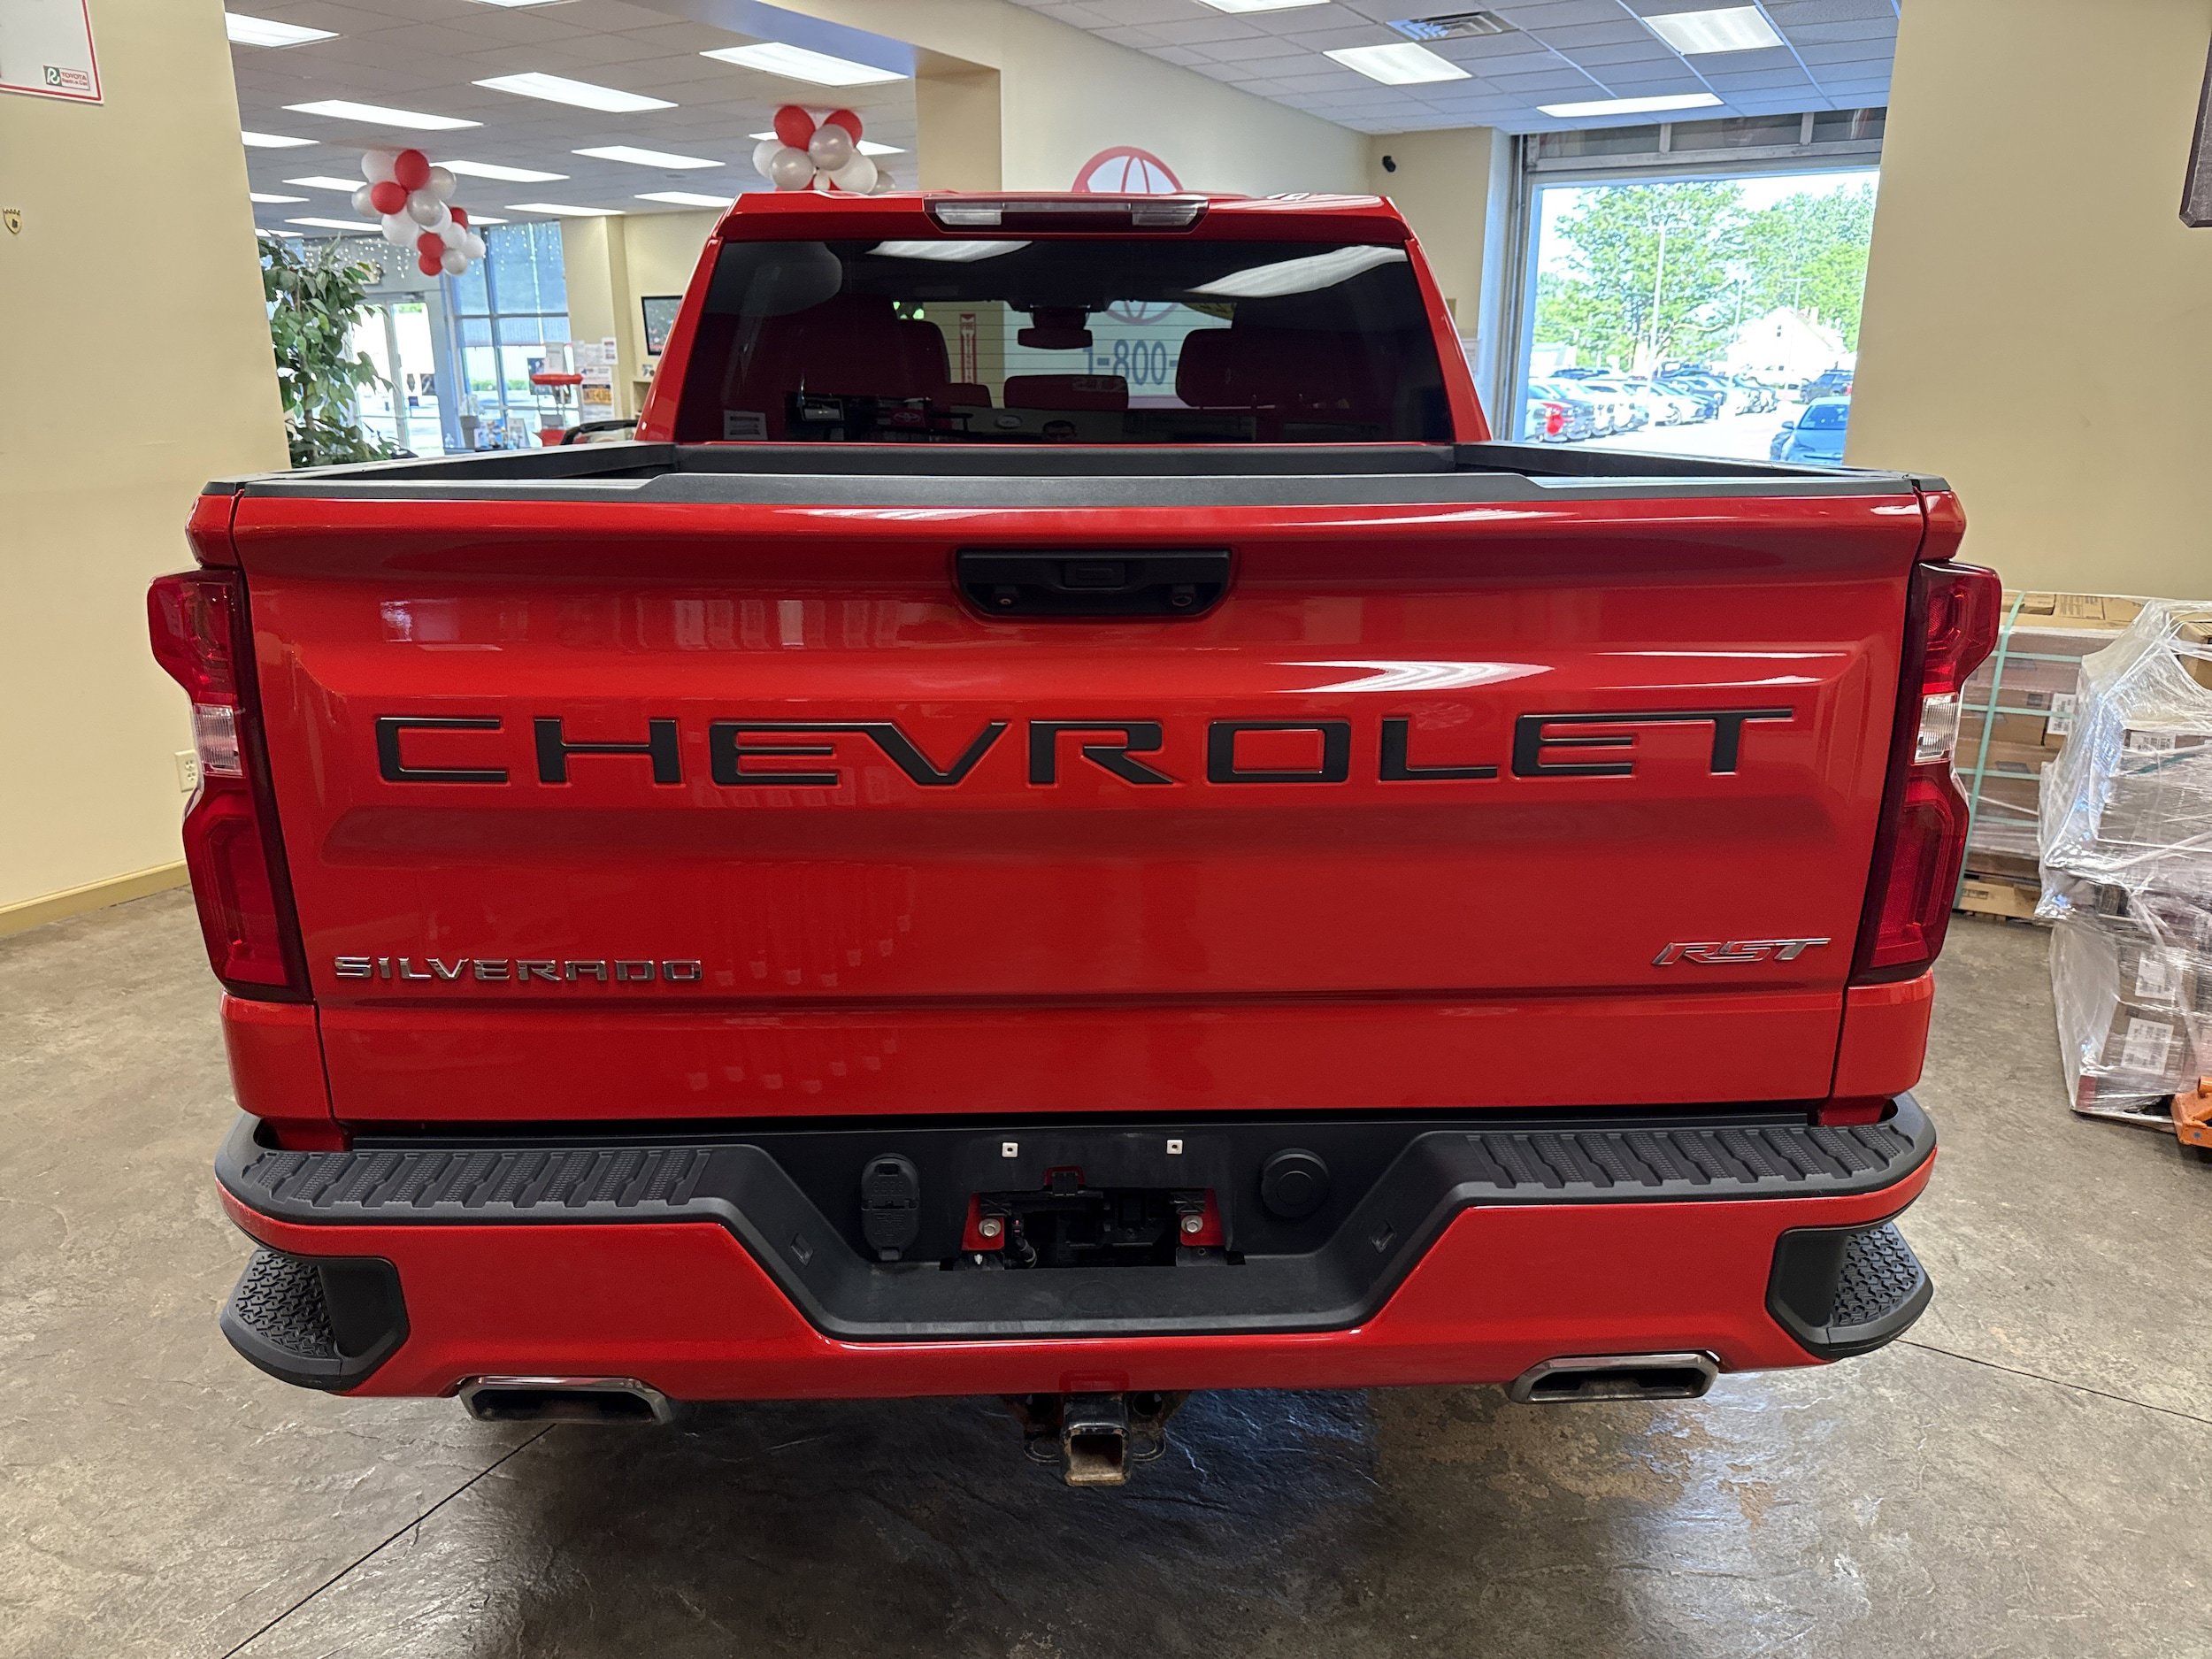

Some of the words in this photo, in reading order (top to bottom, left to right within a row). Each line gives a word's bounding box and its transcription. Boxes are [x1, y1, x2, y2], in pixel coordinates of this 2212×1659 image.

[61, 72, 87, 81] TOYOTA
[376, 708, 1793, 786] CHEVROLET
[1652, 938, 1831, 964] RST
[334, 956, 703, 981] SILVERADO
